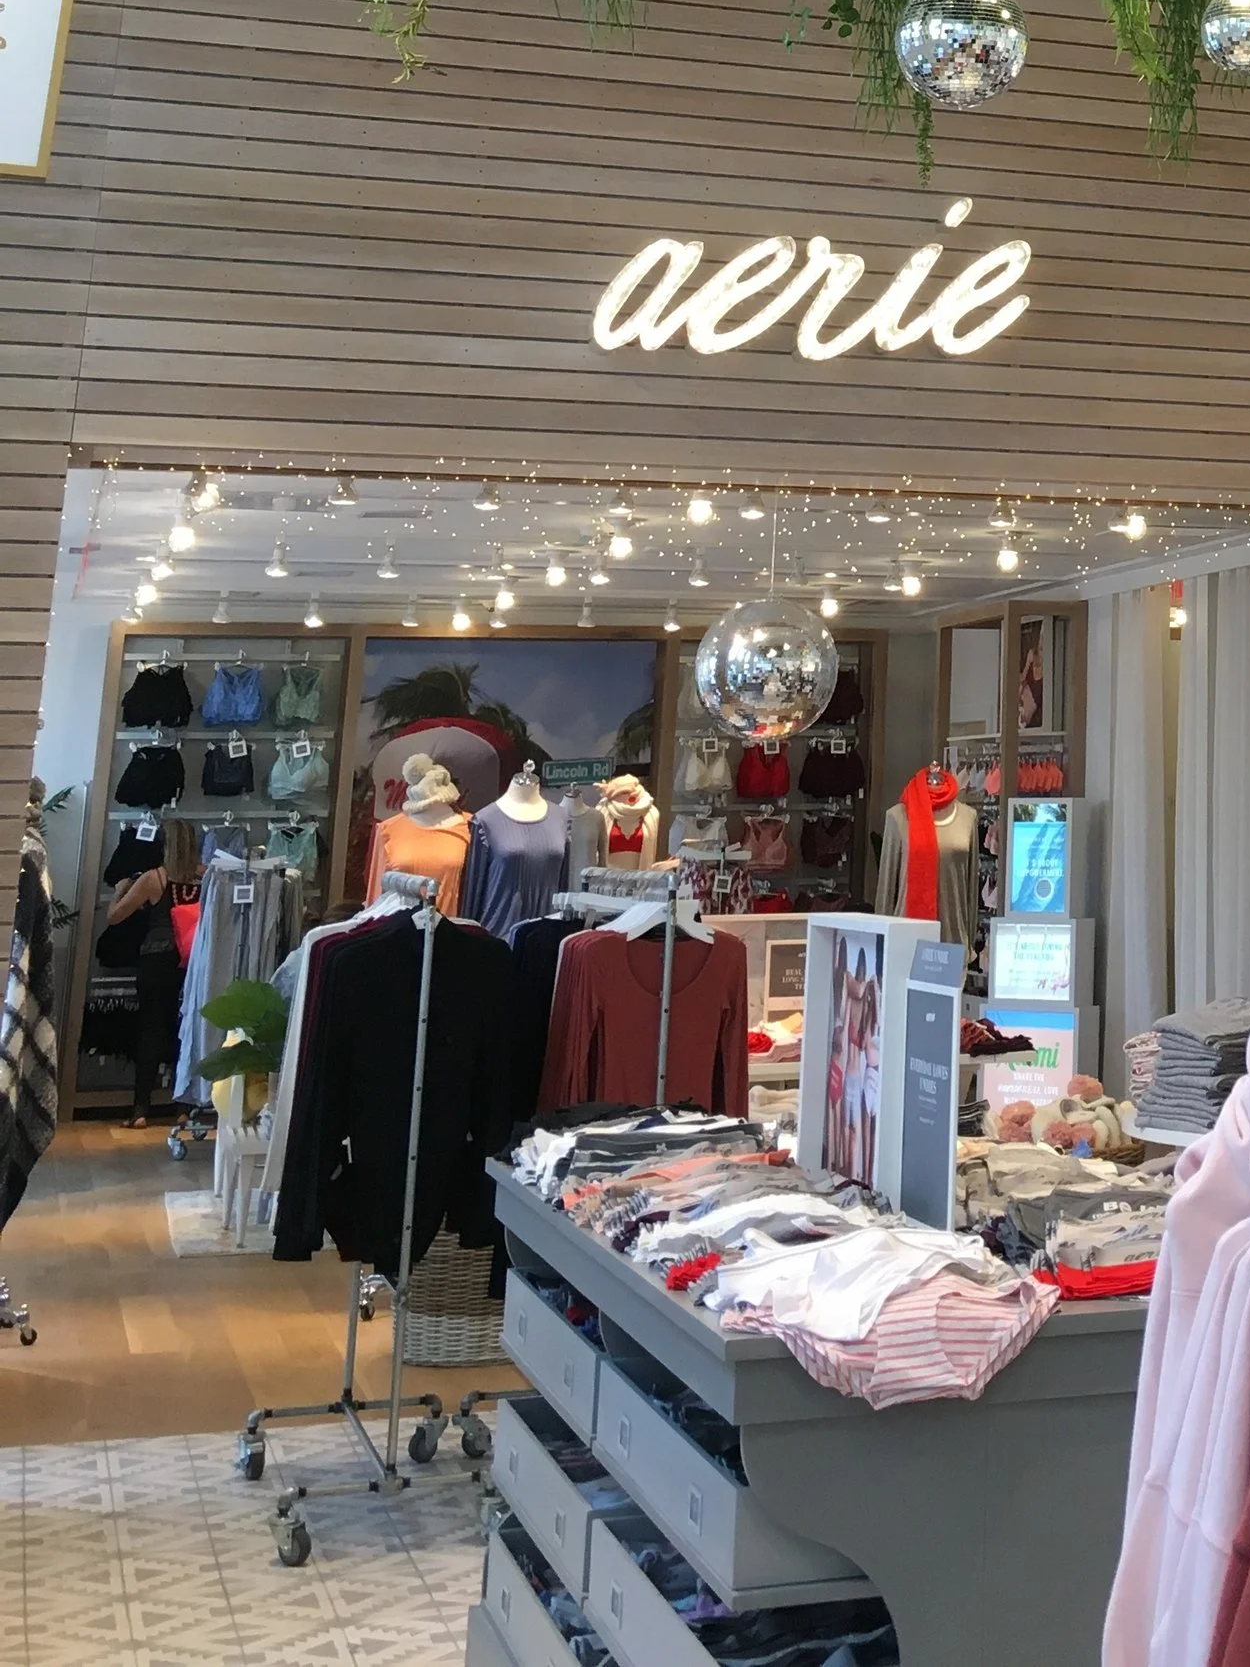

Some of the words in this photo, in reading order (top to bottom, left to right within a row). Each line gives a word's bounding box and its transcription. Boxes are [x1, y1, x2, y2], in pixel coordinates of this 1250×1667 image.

[593, 196, 1031, 362] aerie
[545, 763, 589, 780] Lincoln
[592, 762, 609, 777] Rd
